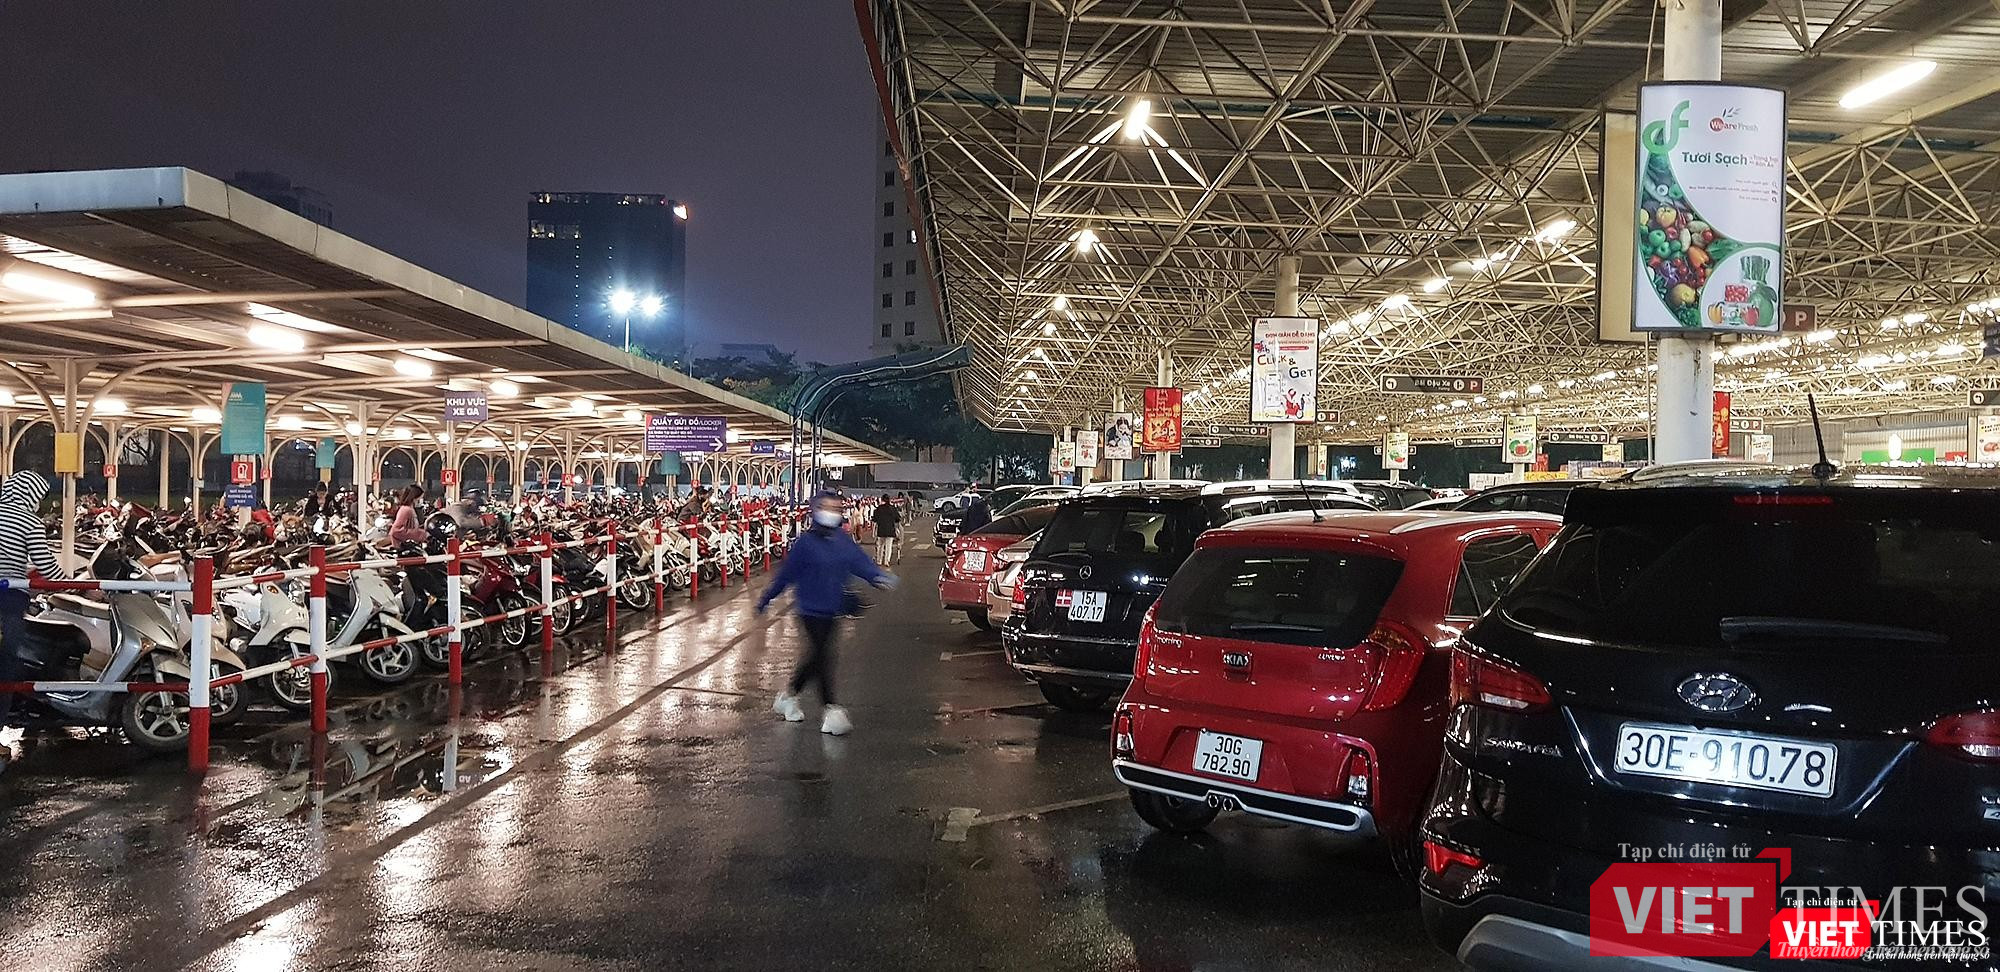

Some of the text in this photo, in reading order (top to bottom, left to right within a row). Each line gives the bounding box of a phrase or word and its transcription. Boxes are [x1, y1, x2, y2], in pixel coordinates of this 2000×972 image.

[1682, 151, 1711, 164] Tươi
[1715, 152, 1748, 168] Sạch
[1795, 310, 1808, 326] P
[1288, 357, 1297, 366] &
[1469, 380, 1478, 391] P
[446, 396, 486, 407] KHU VỰC
[452, 407, 480, 416] XE GA
[1329, 413, 1336, 421] P
[1752, 420, 1760, 429] P
[1081, 591, 1097, 606] 15A
[1070, 605, 1103, 620] 407.17
[1224, 652, 1248, 666] KIA
[1214, 735, 1243, 755] 30G
[1201, 752, 1251, 777] 782.90
[1623, 732, 1827, 788] 30E-910.78
